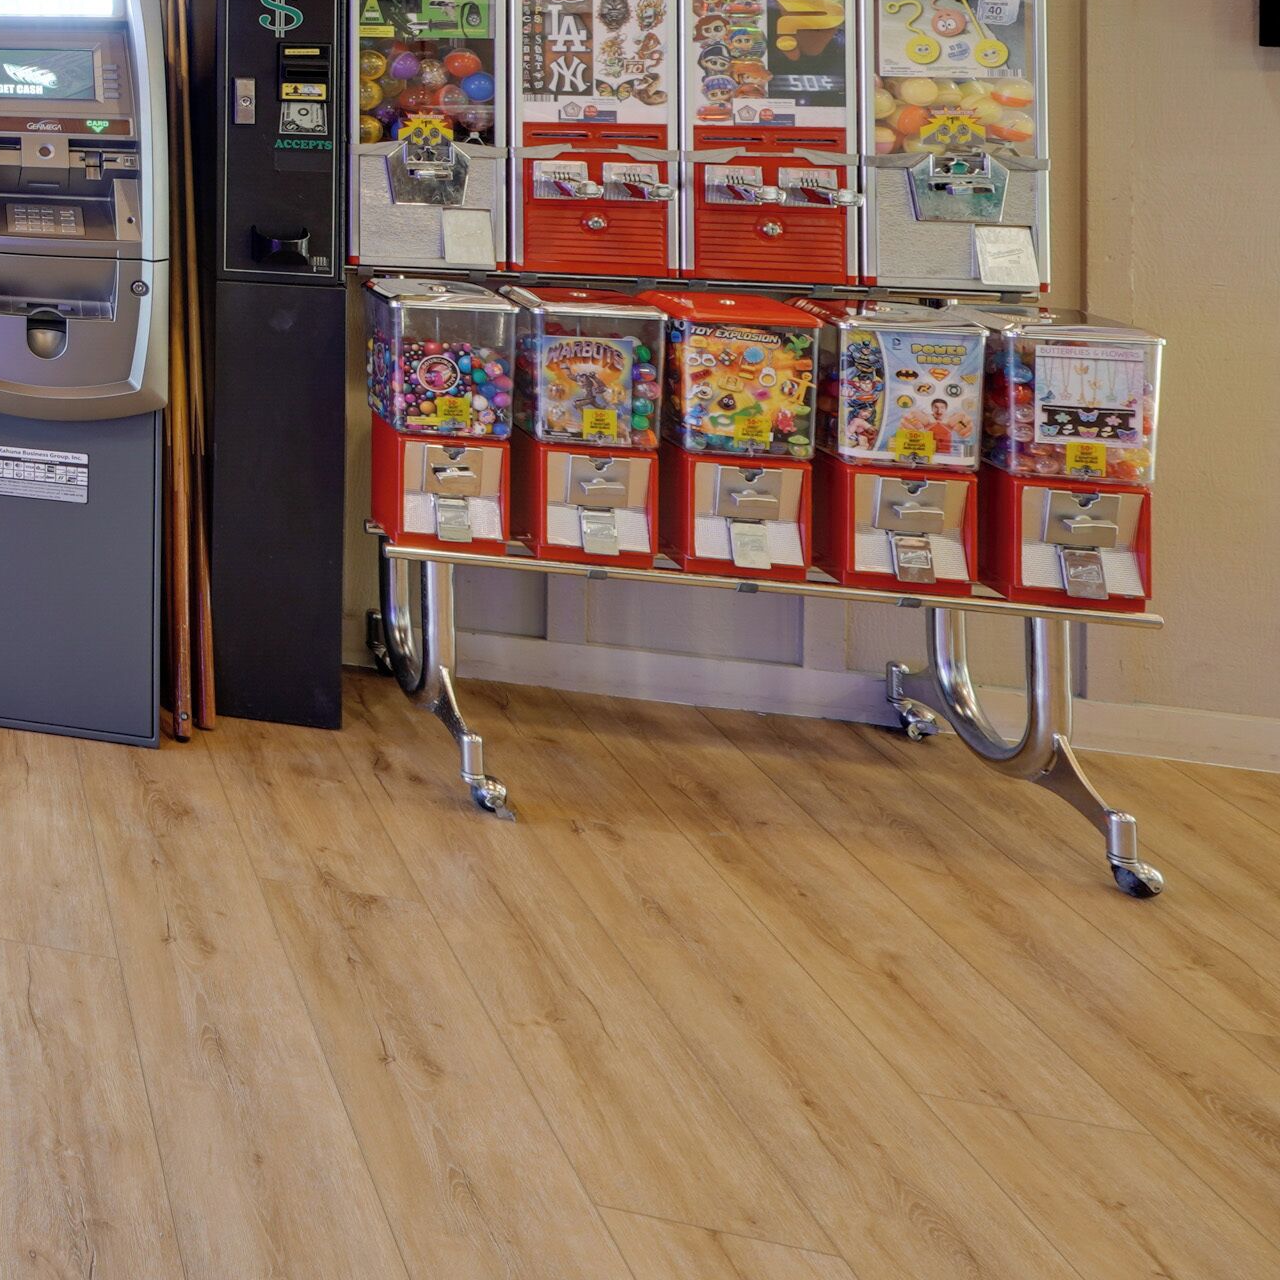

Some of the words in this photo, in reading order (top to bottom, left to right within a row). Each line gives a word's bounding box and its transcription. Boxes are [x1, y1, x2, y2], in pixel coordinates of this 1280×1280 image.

[988, 6, 1002, 15] 40
[789, 75, 833, 91] 50¢
[17, 85, 43, 95] CASH
[26, 122, 62, 131] GENMEGA
[274, 139, 333, 151] ACCEPTS
[690, 325, 713, 336] TOY
[715, 329, 780, 343] EXPLOSION
[546, 340, 625, 370] WARBOTS
[911, 343, 968, 356] POWER
[1040, 347, 1090, 355] BUTTERFLIES
[1101, 350, 1140, 359] FLOWERS
[917, 354, 962, 366] RINGS
[22, 450, 48, 458] Business
